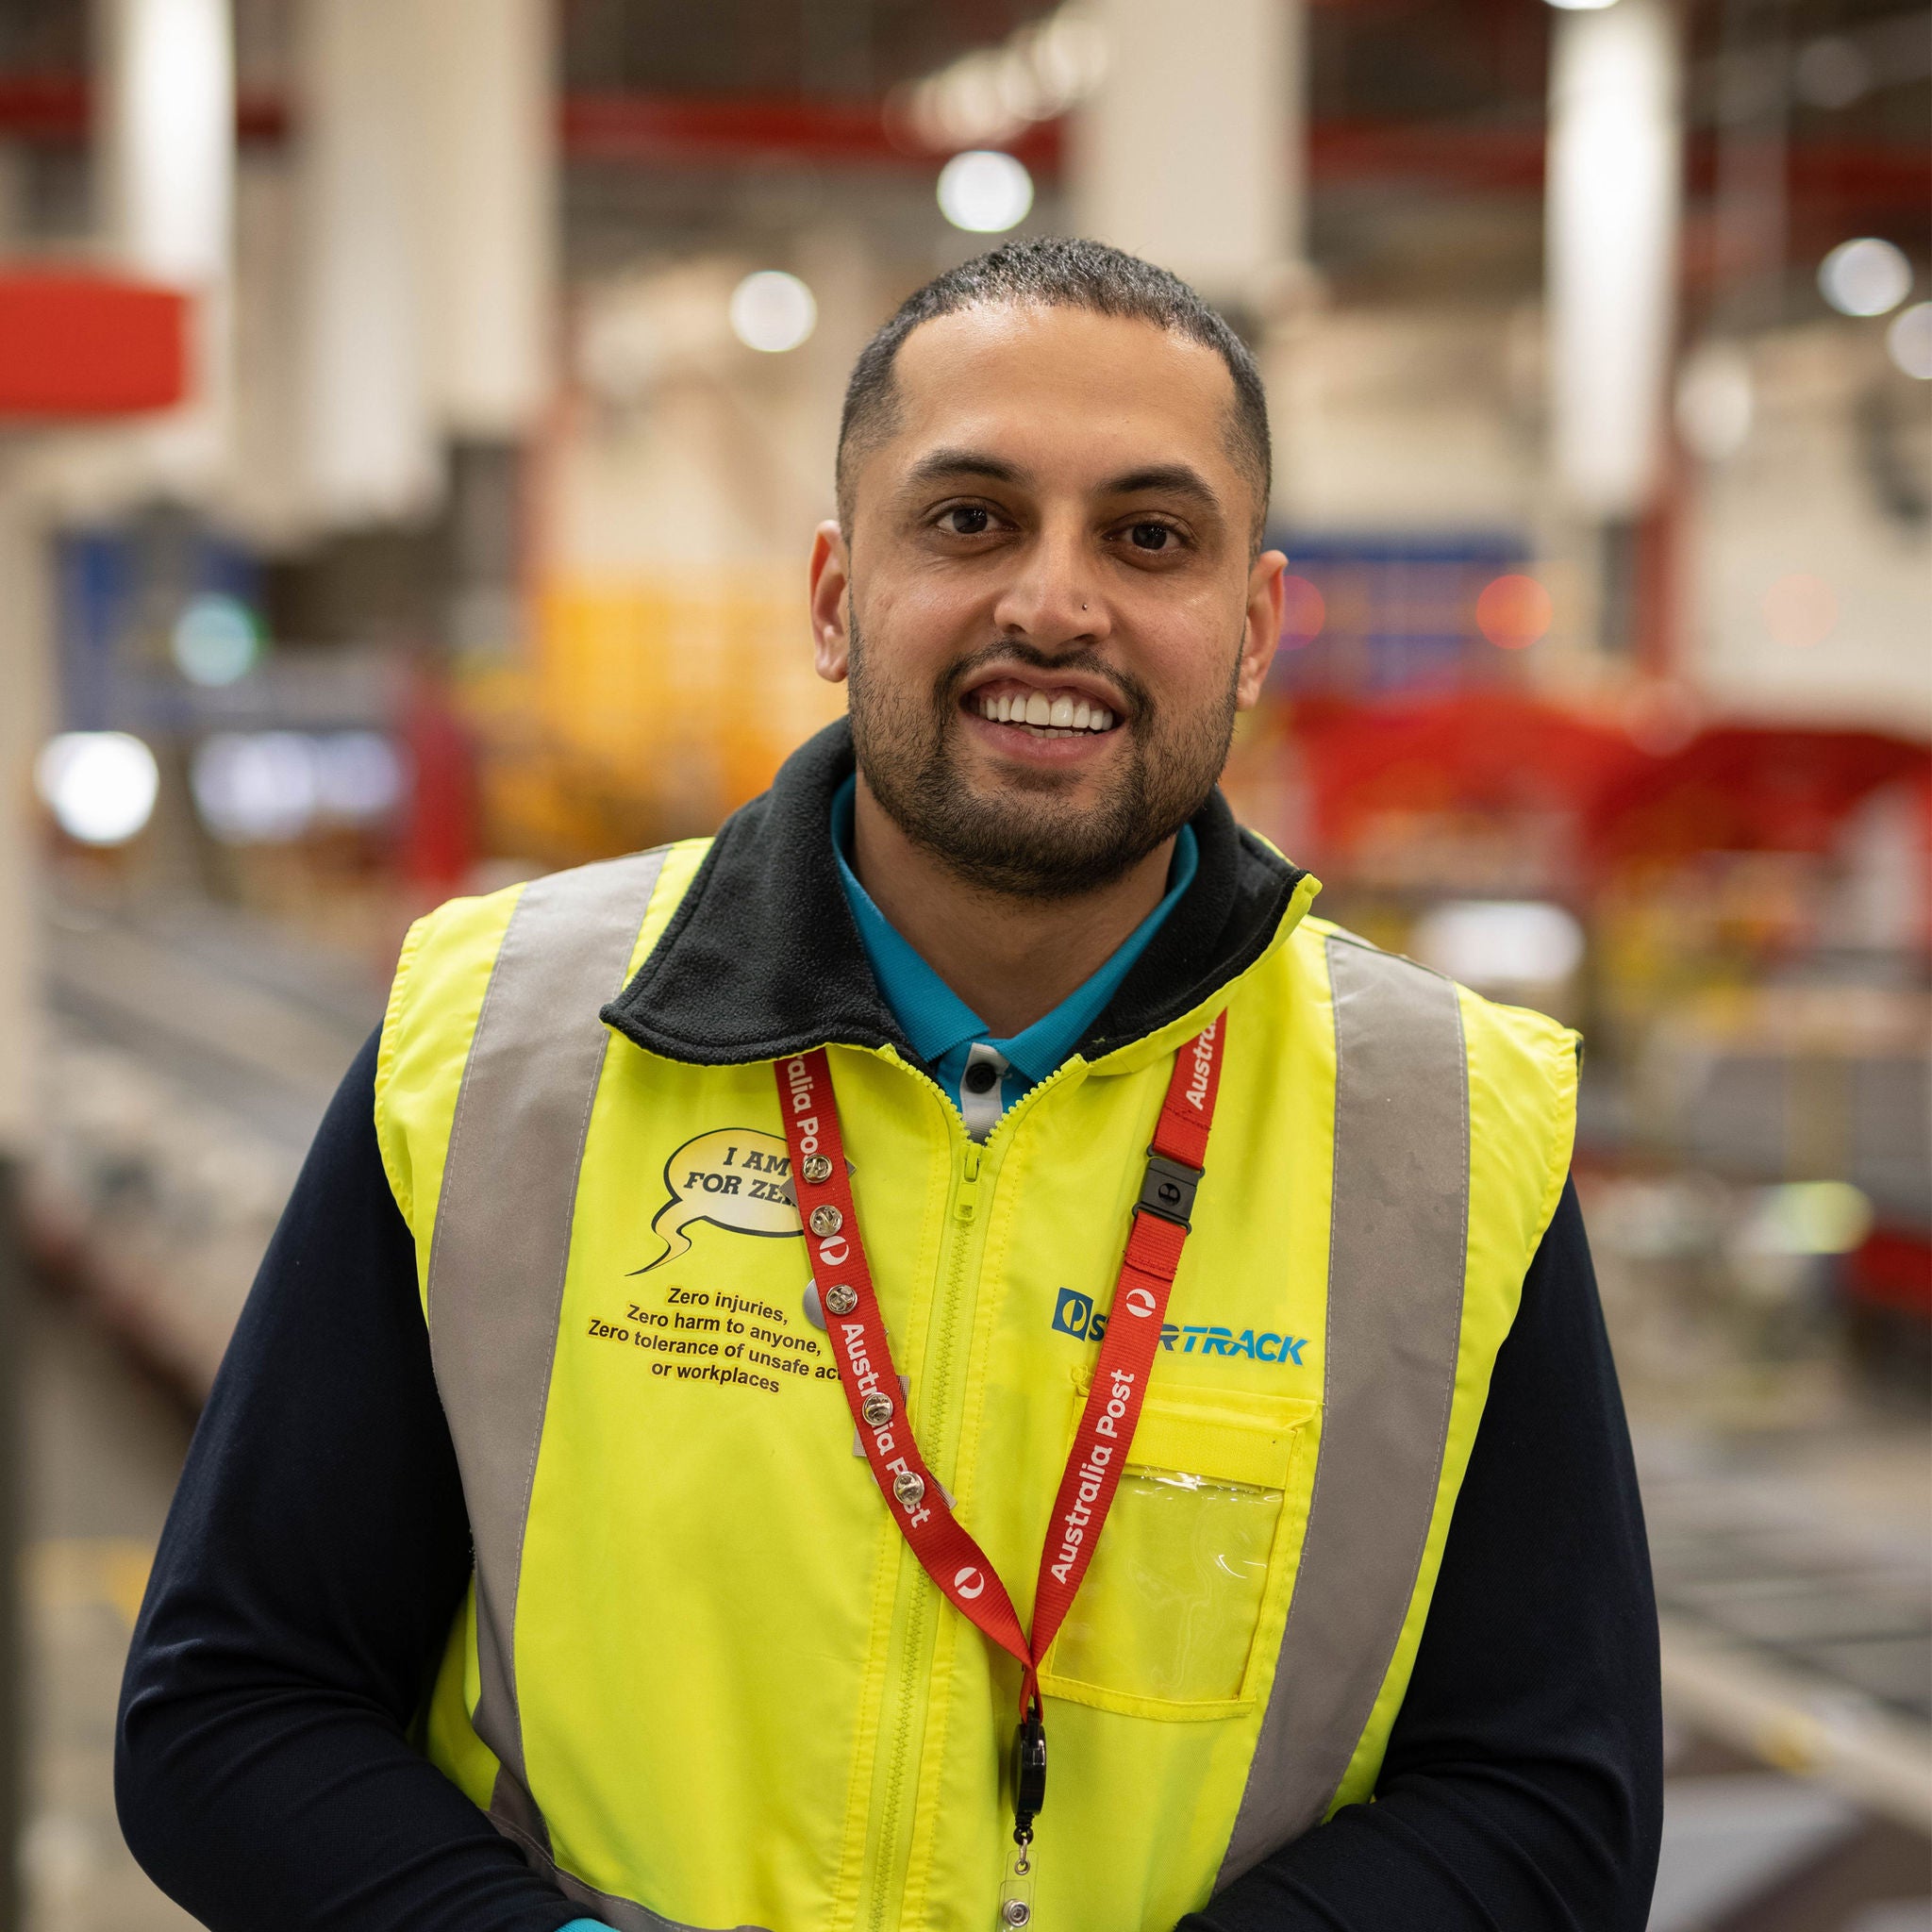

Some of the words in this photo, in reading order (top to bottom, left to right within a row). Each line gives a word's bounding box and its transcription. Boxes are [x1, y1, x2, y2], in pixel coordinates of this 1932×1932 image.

[1186, 1019, 1217, 1110] Austra
[723, 1146, 738, 1166] I
[741, 1150, 791, 1176] AM
[796, 1116, 819, 1160] Po
[683, 1172, 742, 1195] FOR
[747, 1178, 798, 1208] ZE
[626, 1304, 669, 1328] Zero
[674, 1313, 721, 1332] harm
[726, 1317, 745, 1335] to
[750, 1325, 821, 1357] anyone,
[667, 1287, 709, 1307] Zero
[714, 1291, 788, 1325] injuries,
[588, 1319, 629, 1342] Zero
[634, 1330, 720, 1357] tolerance
[724, 1341, 744, 1359] of
[748, 1347, 809, 1376] unsafe
[1089, 1313, 1308, 1366] SRTRACK
[651, 1364, 673, 1377] or
[676, 1365, 780, 1394] workplaces
[841, 1324, 895, 1457] Austria
[1051, 1444, 1113, 1585] Australia
[1095, 1369, 1135, 1439] Post
